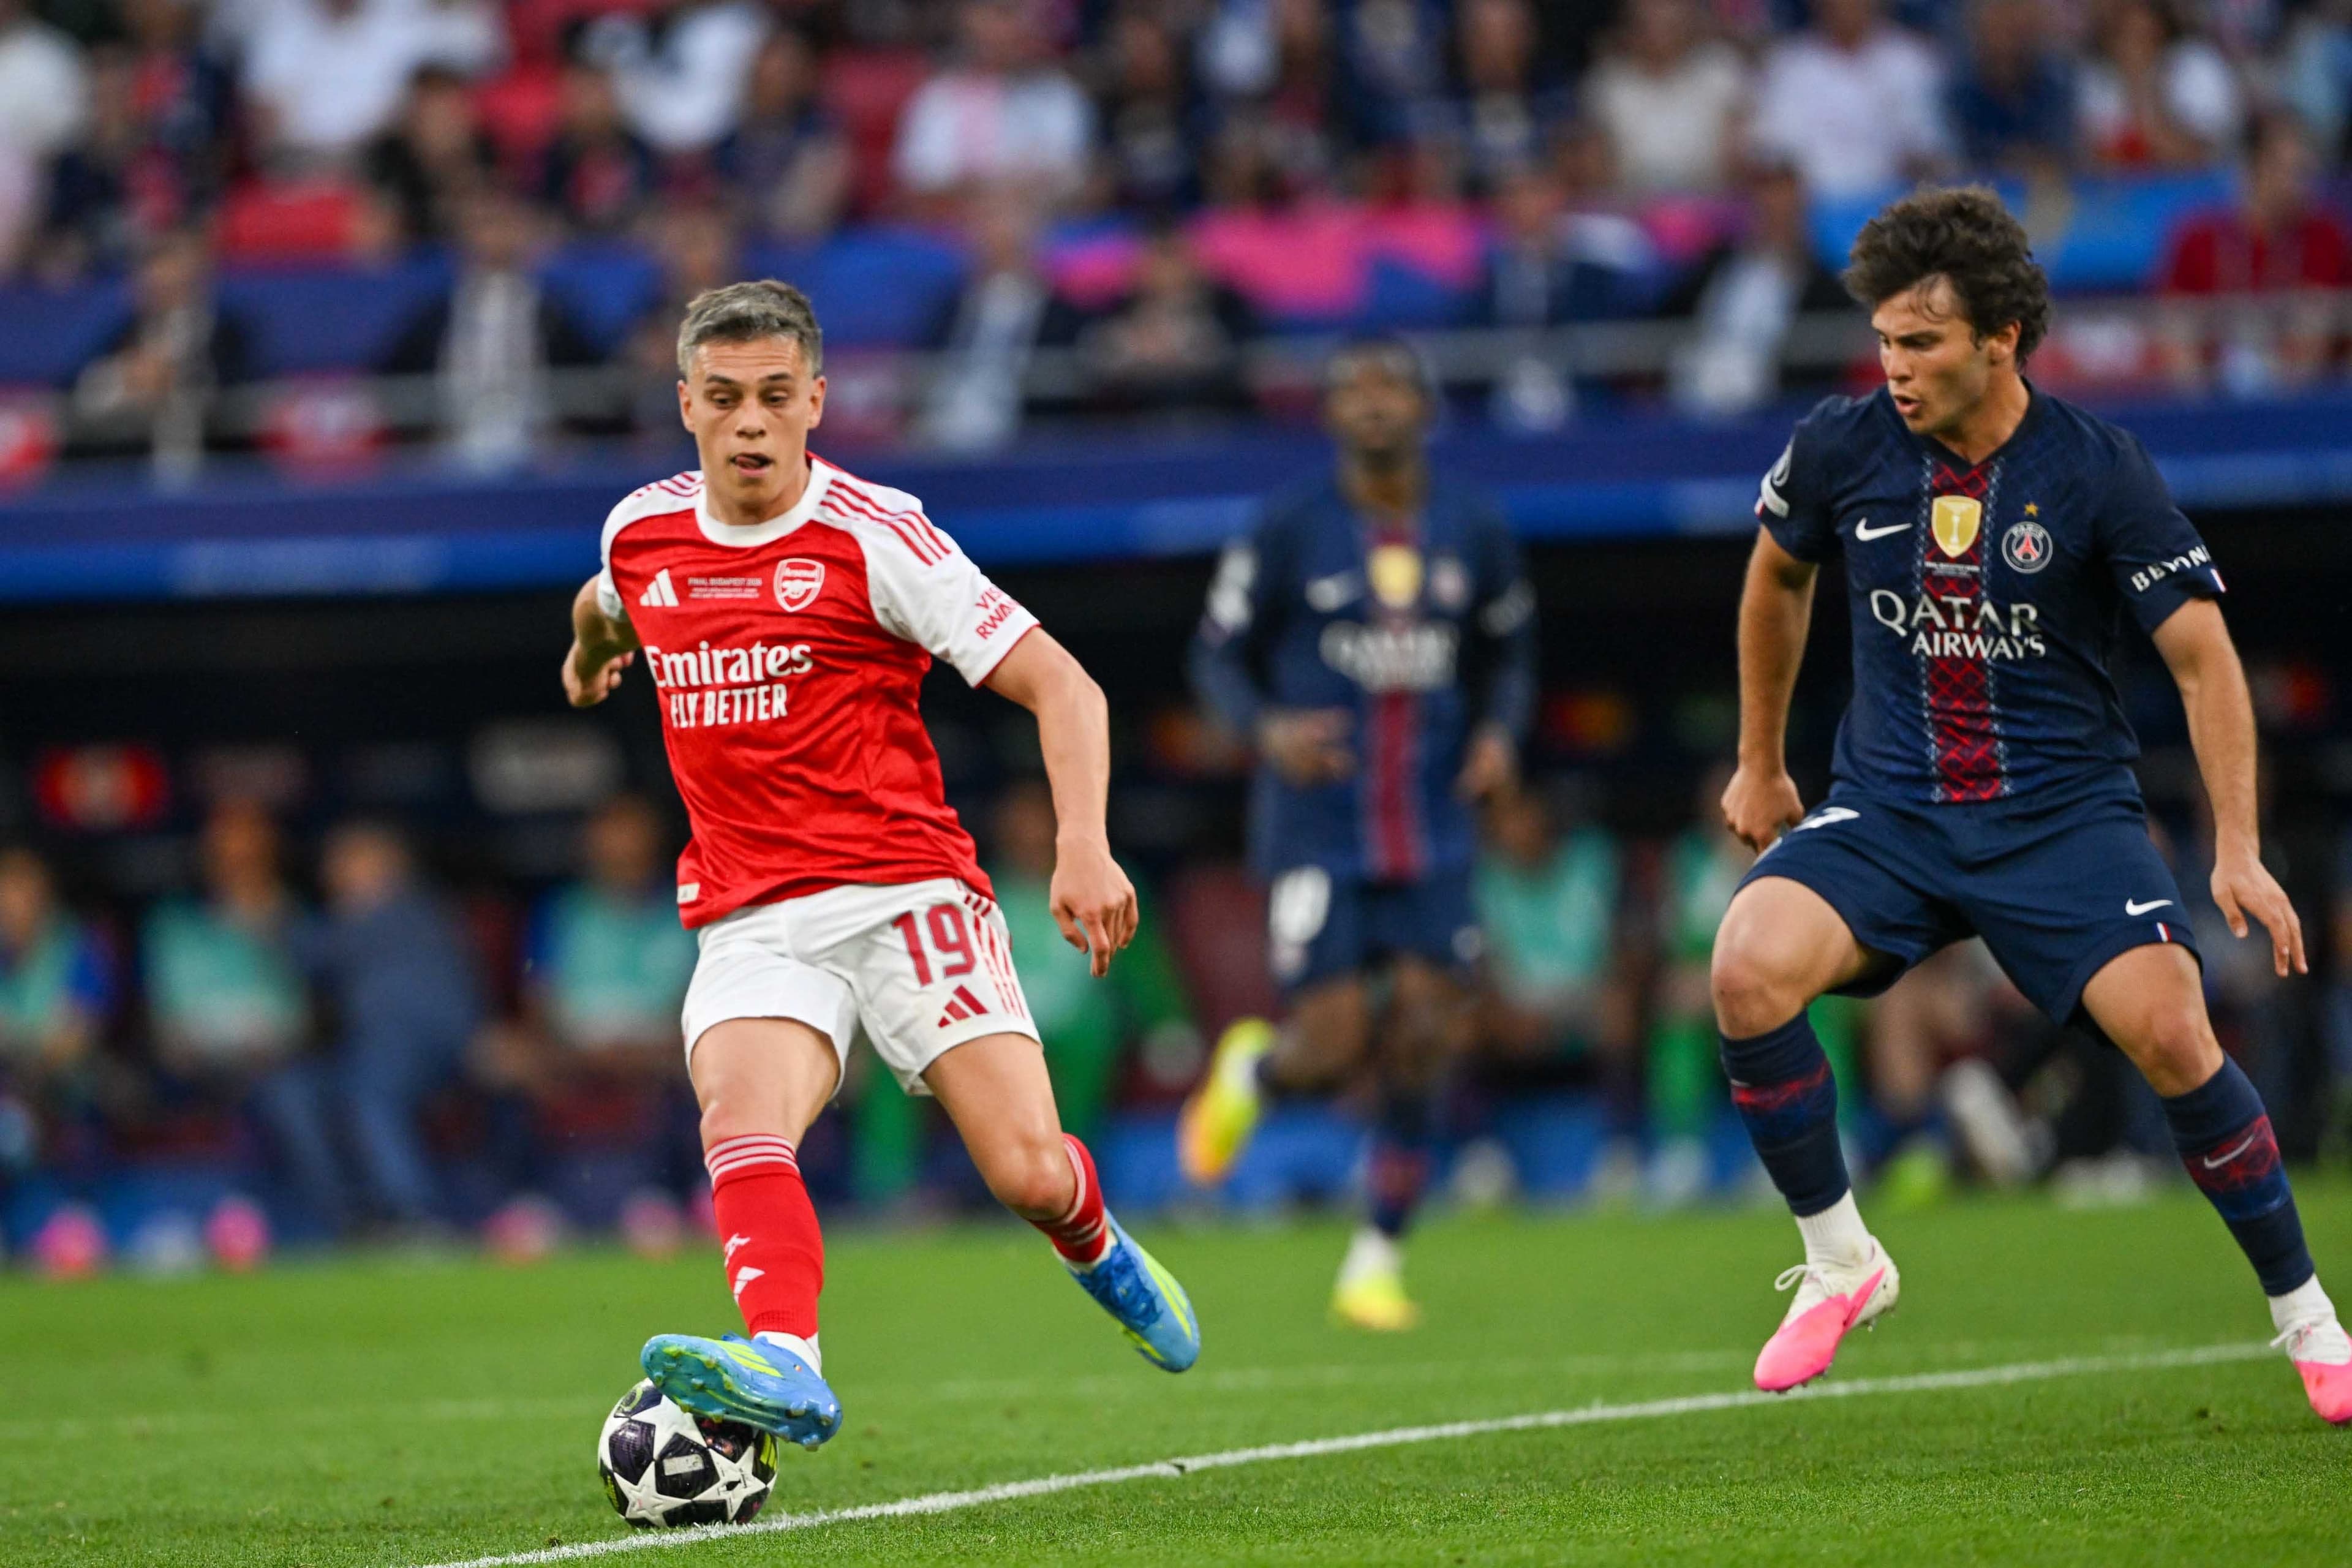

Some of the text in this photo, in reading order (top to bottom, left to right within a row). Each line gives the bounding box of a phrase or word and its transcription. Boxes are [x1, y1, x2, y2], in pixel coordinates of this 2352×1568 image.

[1870, 589, 2042, 637] QATAR
[644, 640, 813, 688] Emirates
[1912, 631, 2046, 660] AIRWAYS
[670, 684, 788, 728] FLY BETTER
[891, 902, 976, 987] 19
